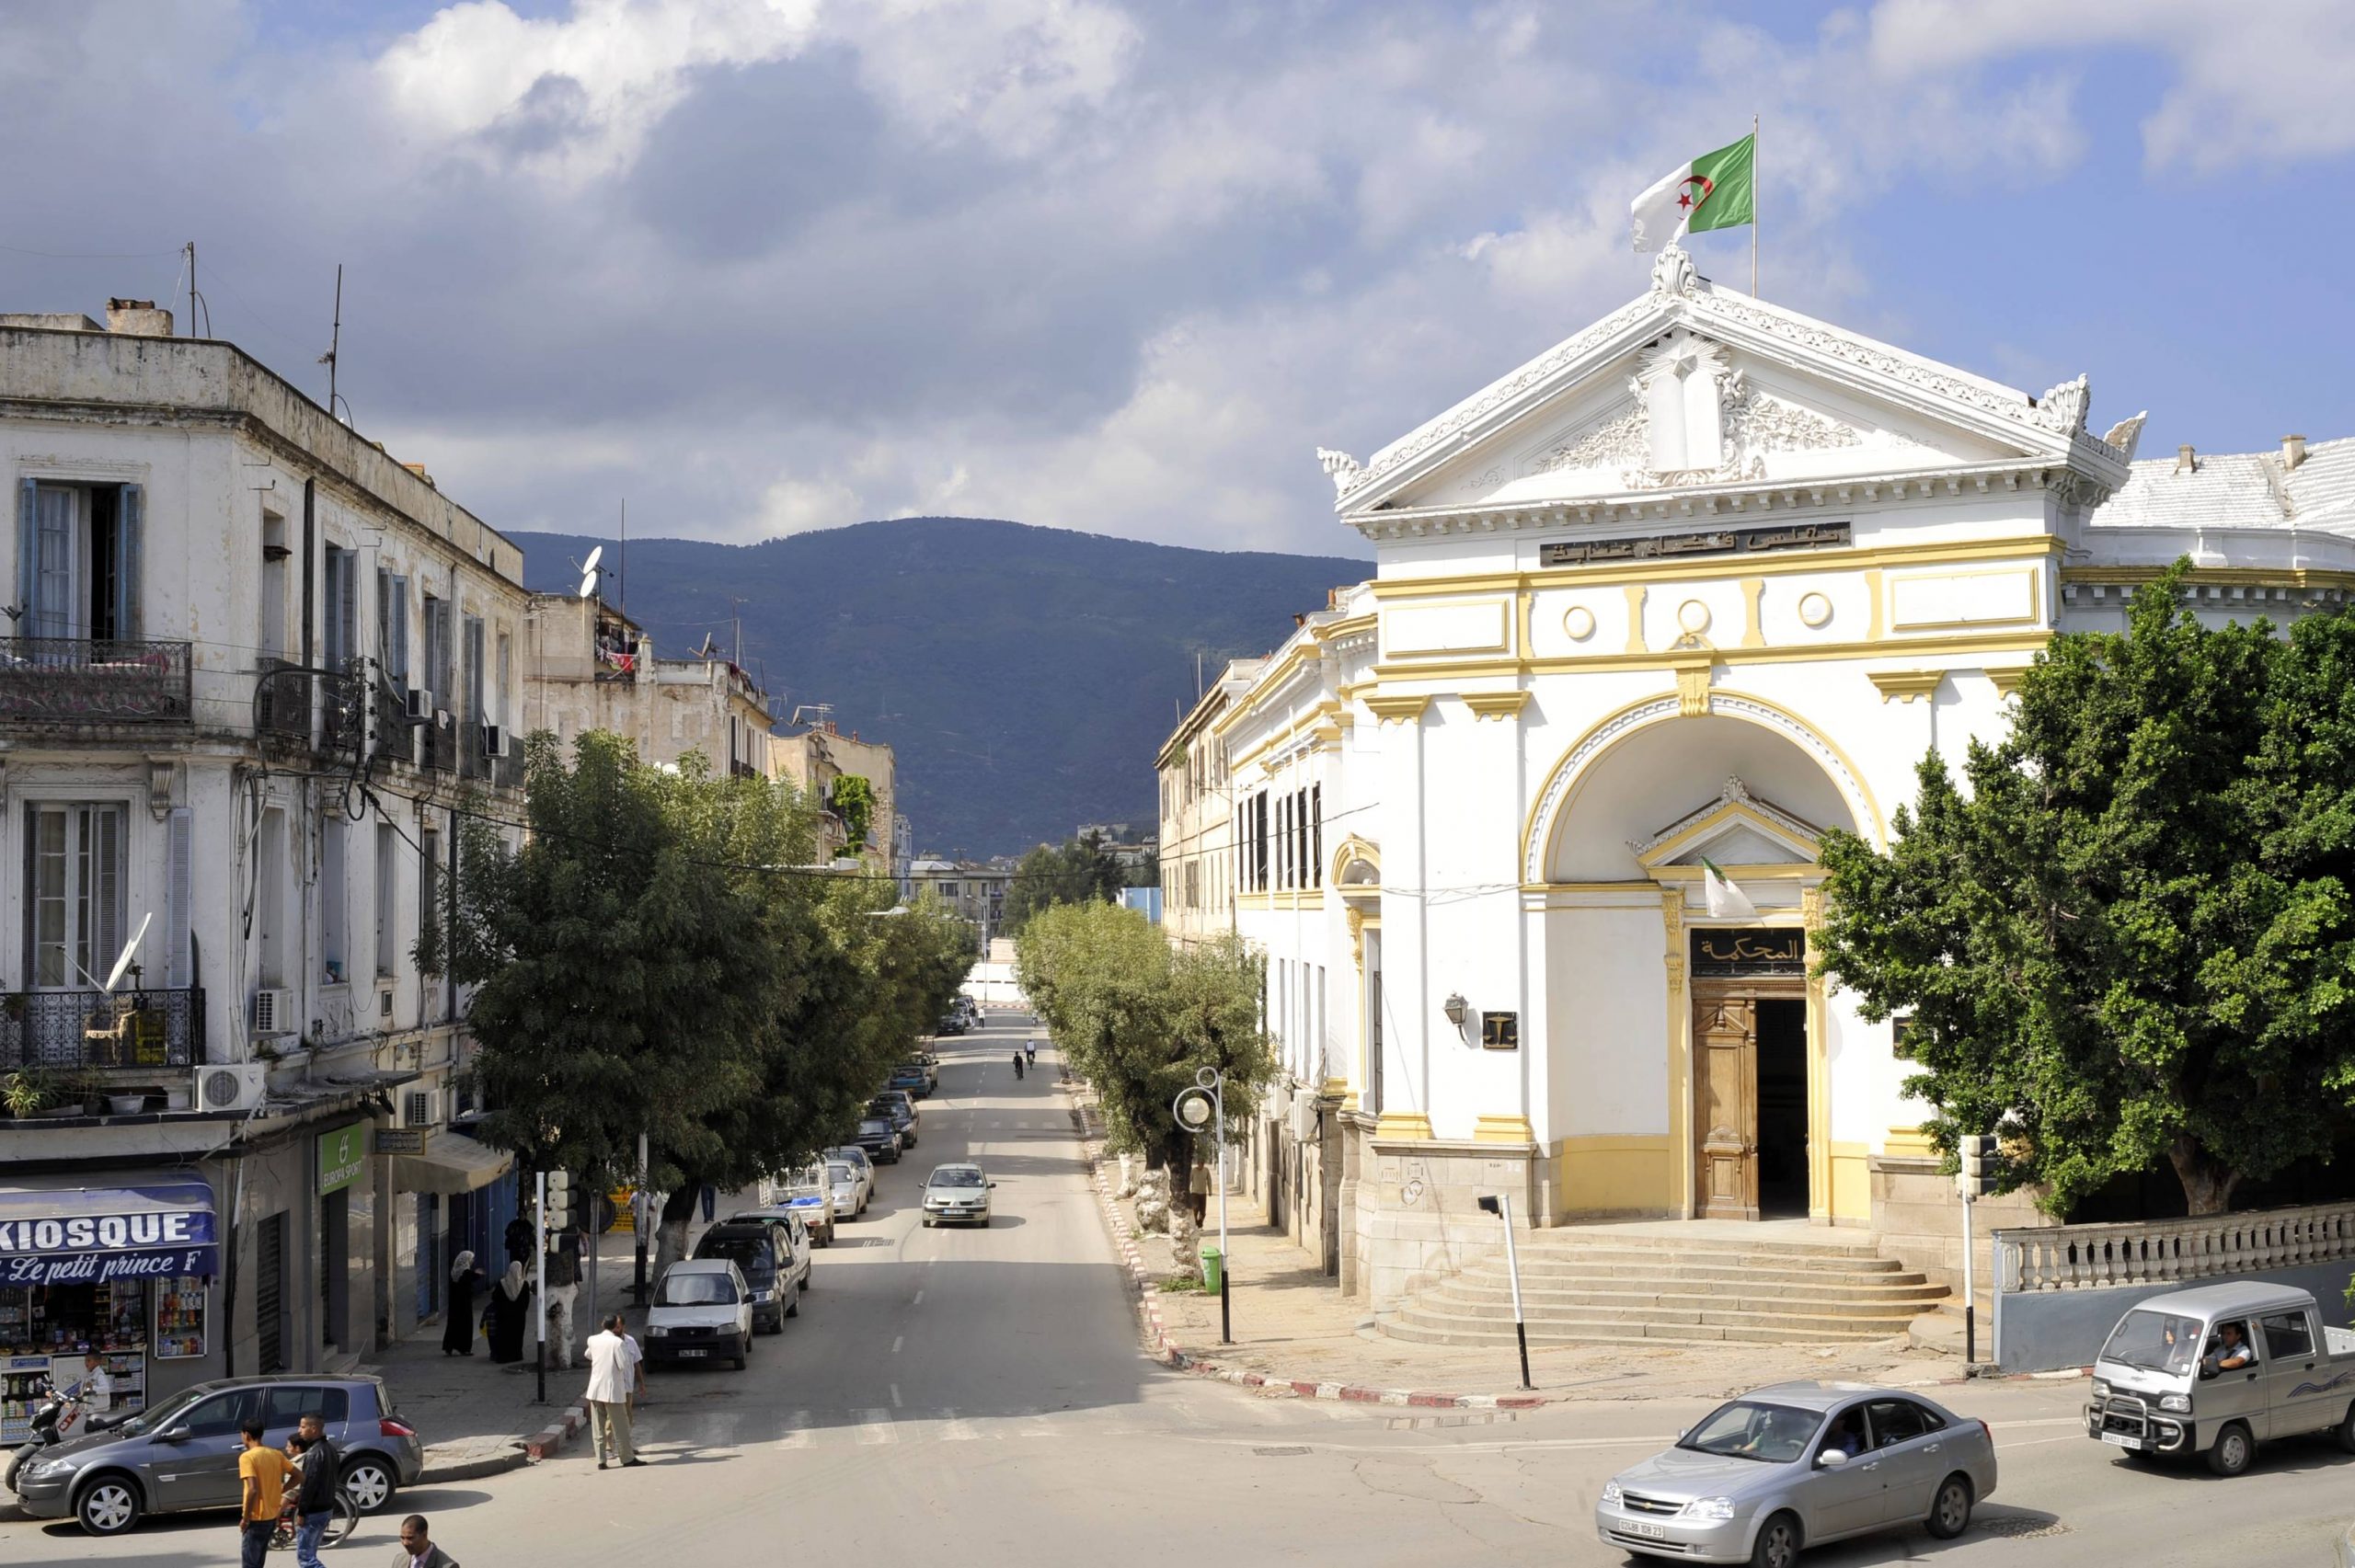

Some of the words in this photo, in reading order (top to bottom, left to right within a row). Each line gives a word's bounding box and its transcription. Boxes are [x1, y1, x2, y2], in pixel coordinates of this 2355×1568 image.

[1702, 937, 1798, 960] المحكمة
[324, 1167, 345, 1187] EUROPA
[345, 1160, 362, 1179] SPORT
[8, 1256, 45, 1281] Le
[43, 1253, 99, 1286] petit
[98, 1253, 175, 1284] prince
